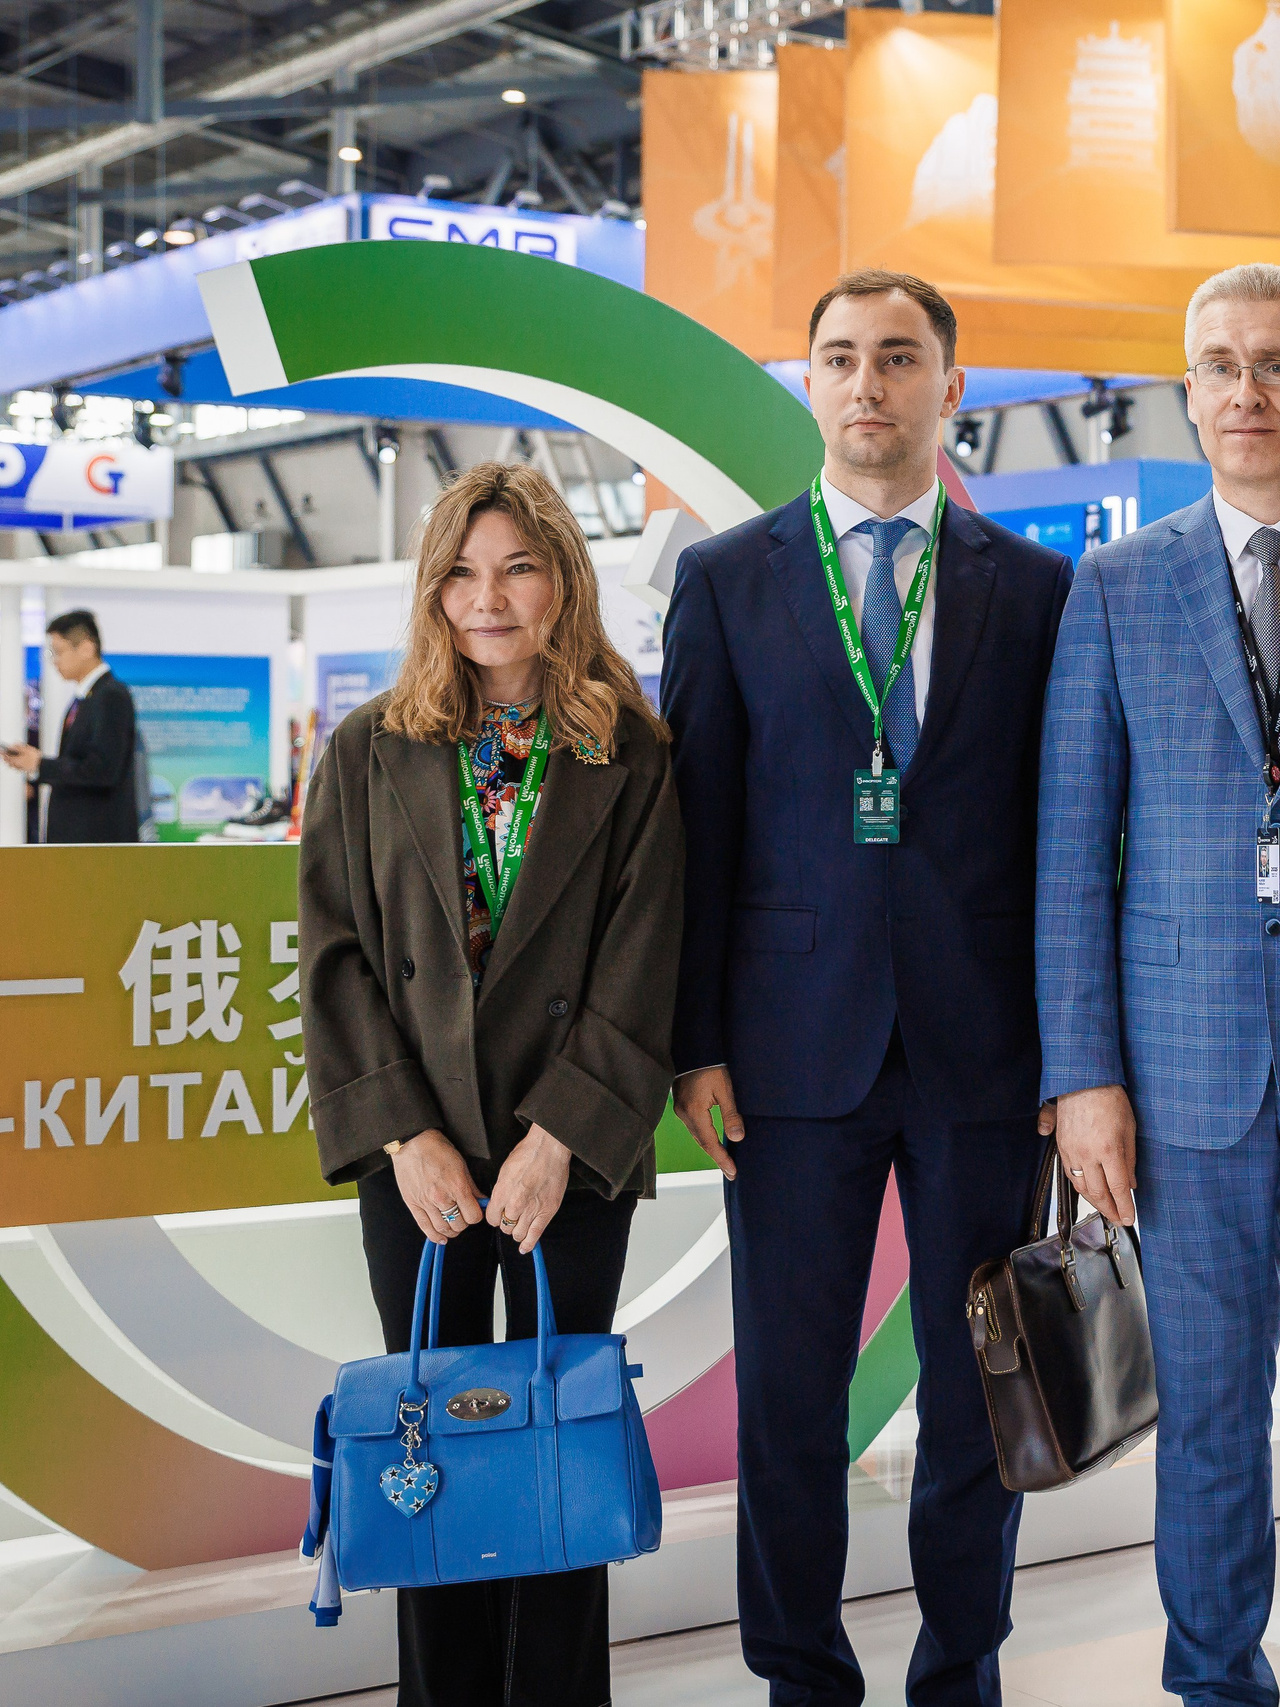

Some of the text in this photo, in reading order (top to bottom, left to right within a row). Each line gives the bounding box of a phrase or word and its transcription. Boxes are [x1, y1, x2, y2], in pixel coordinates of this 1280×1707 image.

[814, 512, 828, 554] ИННОПРОМ
[826, 564, 841, 607] ИННОПРОМ
[915, 563, 929, 603] INNOPROM
[840, 618, 856, 660] INNOPROM
[901, 615, 917, 659] ИННОПРОМ
[521, 755, 538, 798] ИННОПРОМ
[470, 799, 486, 844] INNOPROM
[508, 809, 523, 852] INNOPROM
